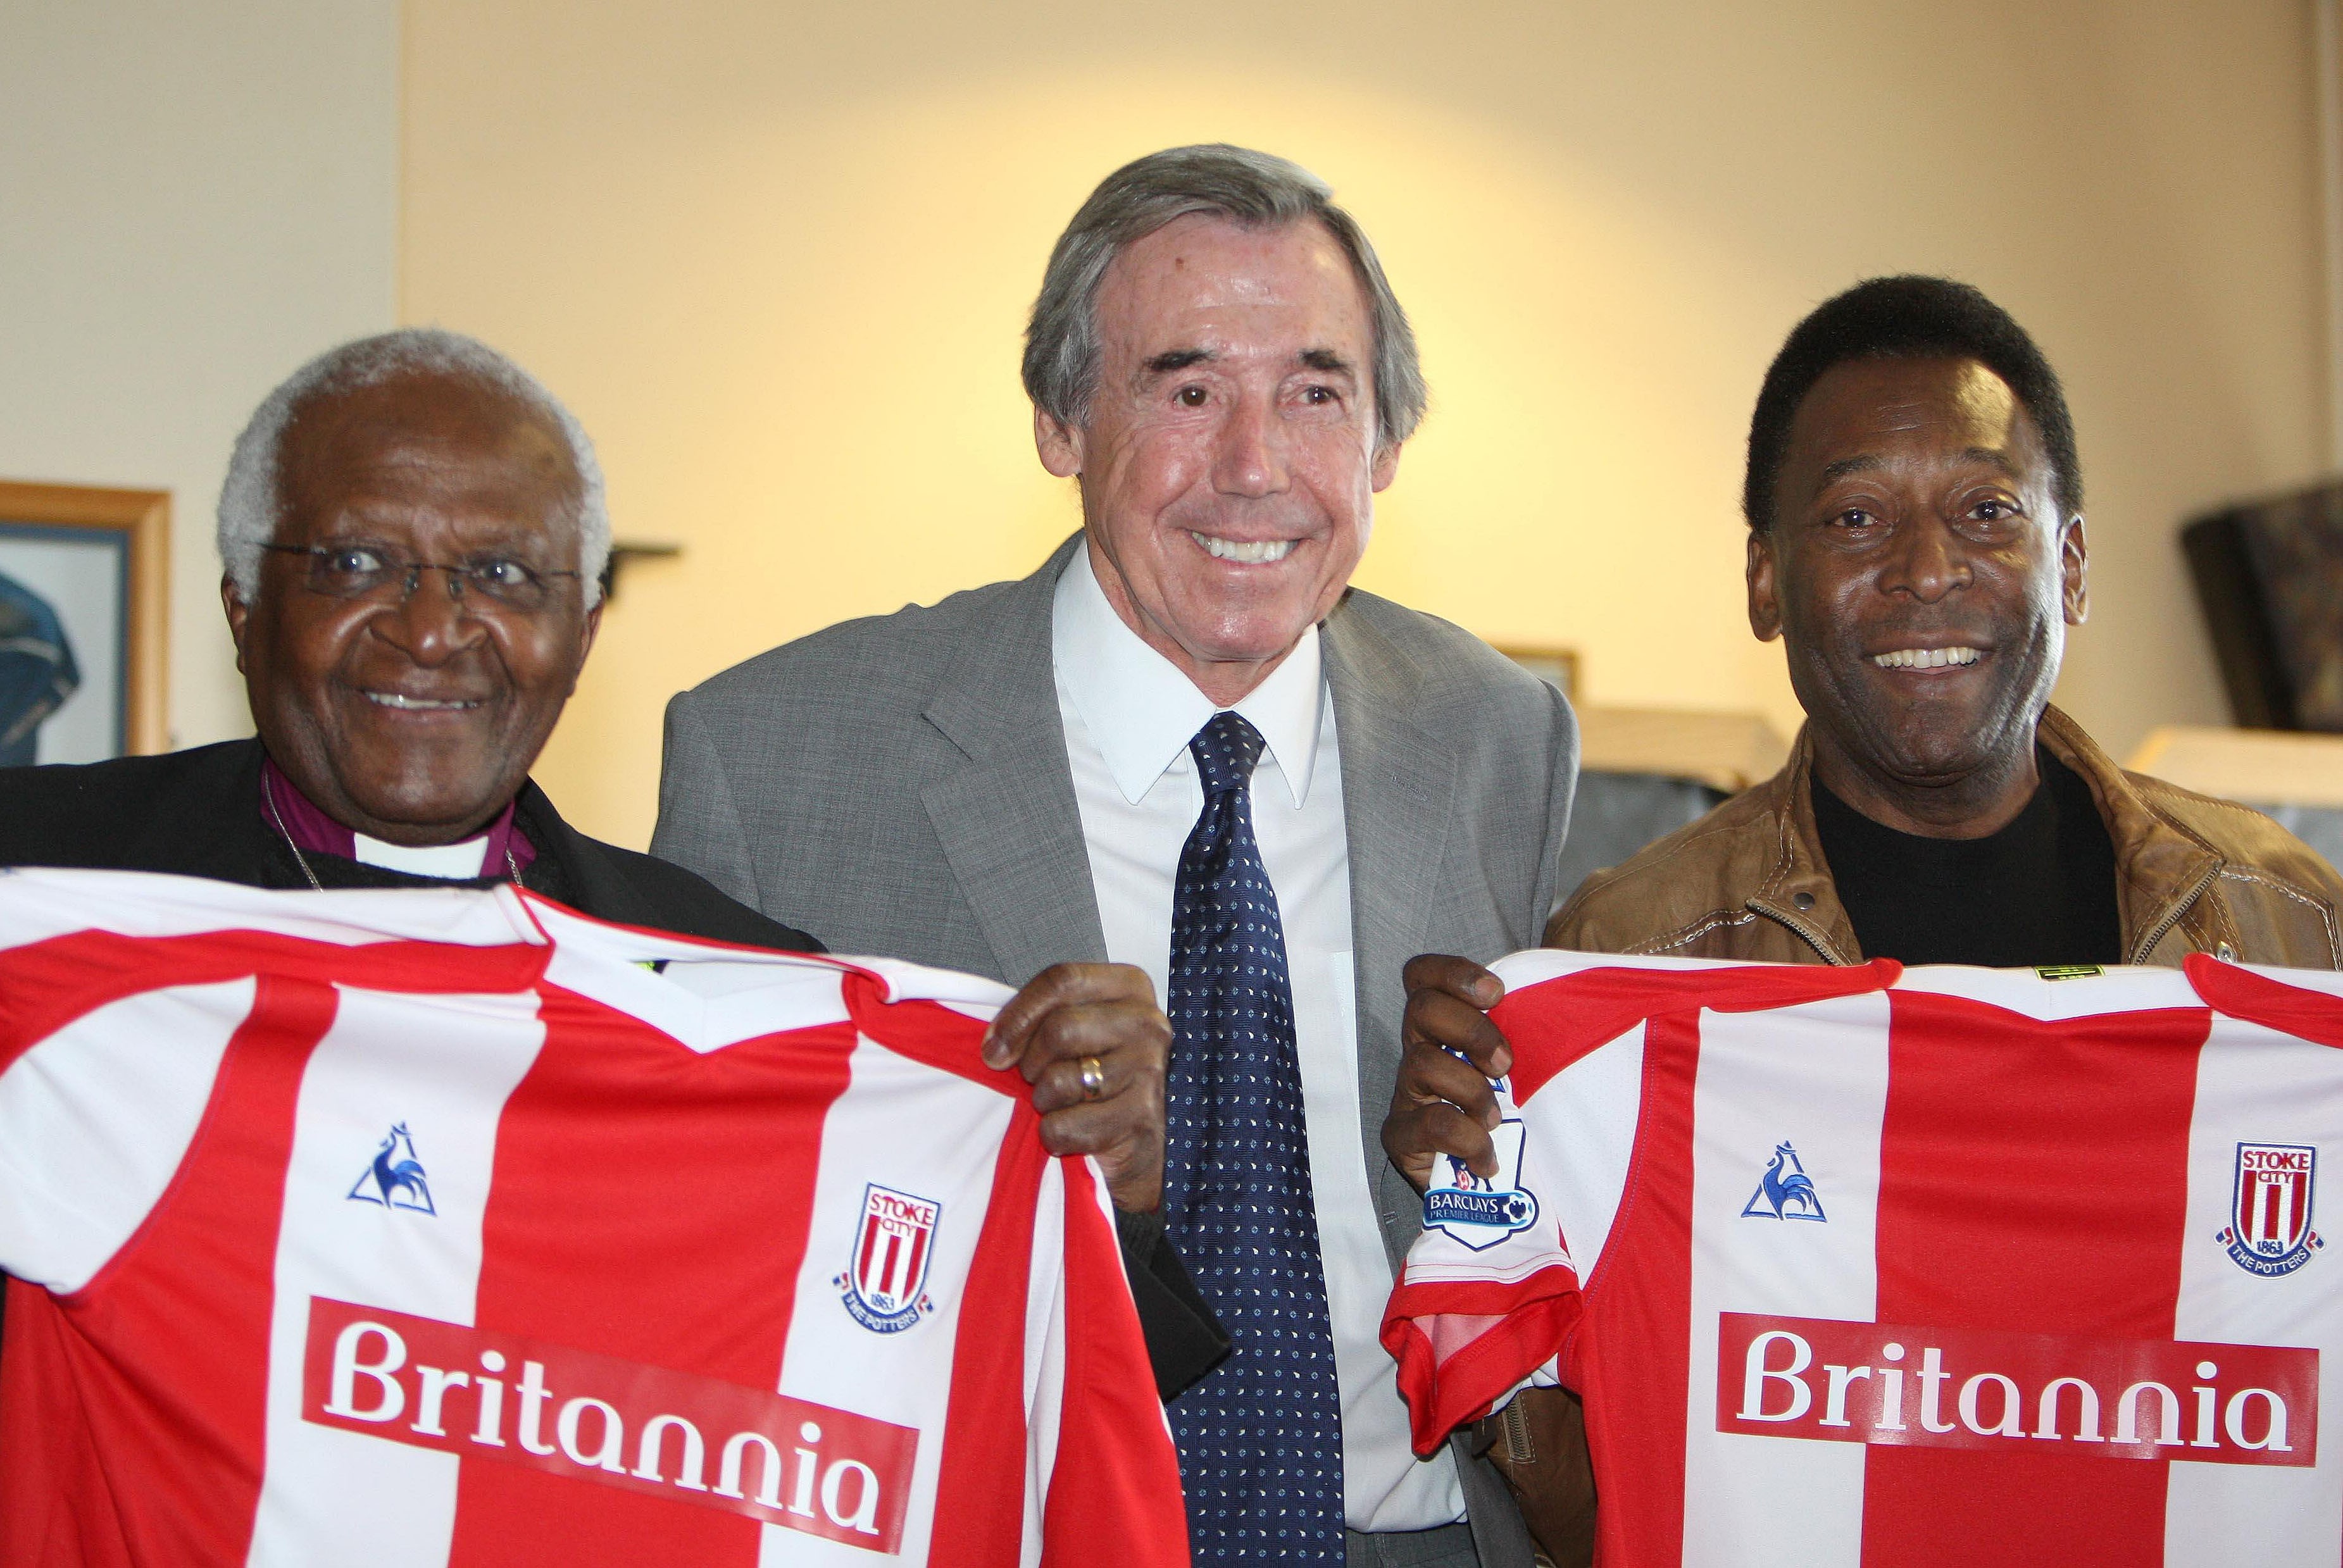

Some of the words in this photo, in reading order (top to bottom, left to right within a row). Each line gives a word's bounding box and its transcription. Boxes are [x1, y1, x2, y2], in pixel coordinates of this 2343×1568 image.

[2243, 1151, 2309, 1169] STOKE
[2258, 1171, 2294, 1183] CITY
[870, 1193, 934, 1226] STOKE
[1430, 1193, 1498, 1213] BARCLAYS
[1430, 1209, 1469, 1220] PREMIER
[1470, 1211, 1500, 1223] LEAGUE
[880, 1219, 914, 1237] CITY
[2256, 1240, 2284, 1255] 1863
[2232, 1245, 2254, 1267] THE
[2254, 1249, 2307, 1273] POTTERS
[845, 1292, 867, 1322] THE
[865, 1307, 918, 1331] POTTERS
[1736, 1331, 2292, 1452] Britannia
[322, 1321, 879, 1536] Britannia
